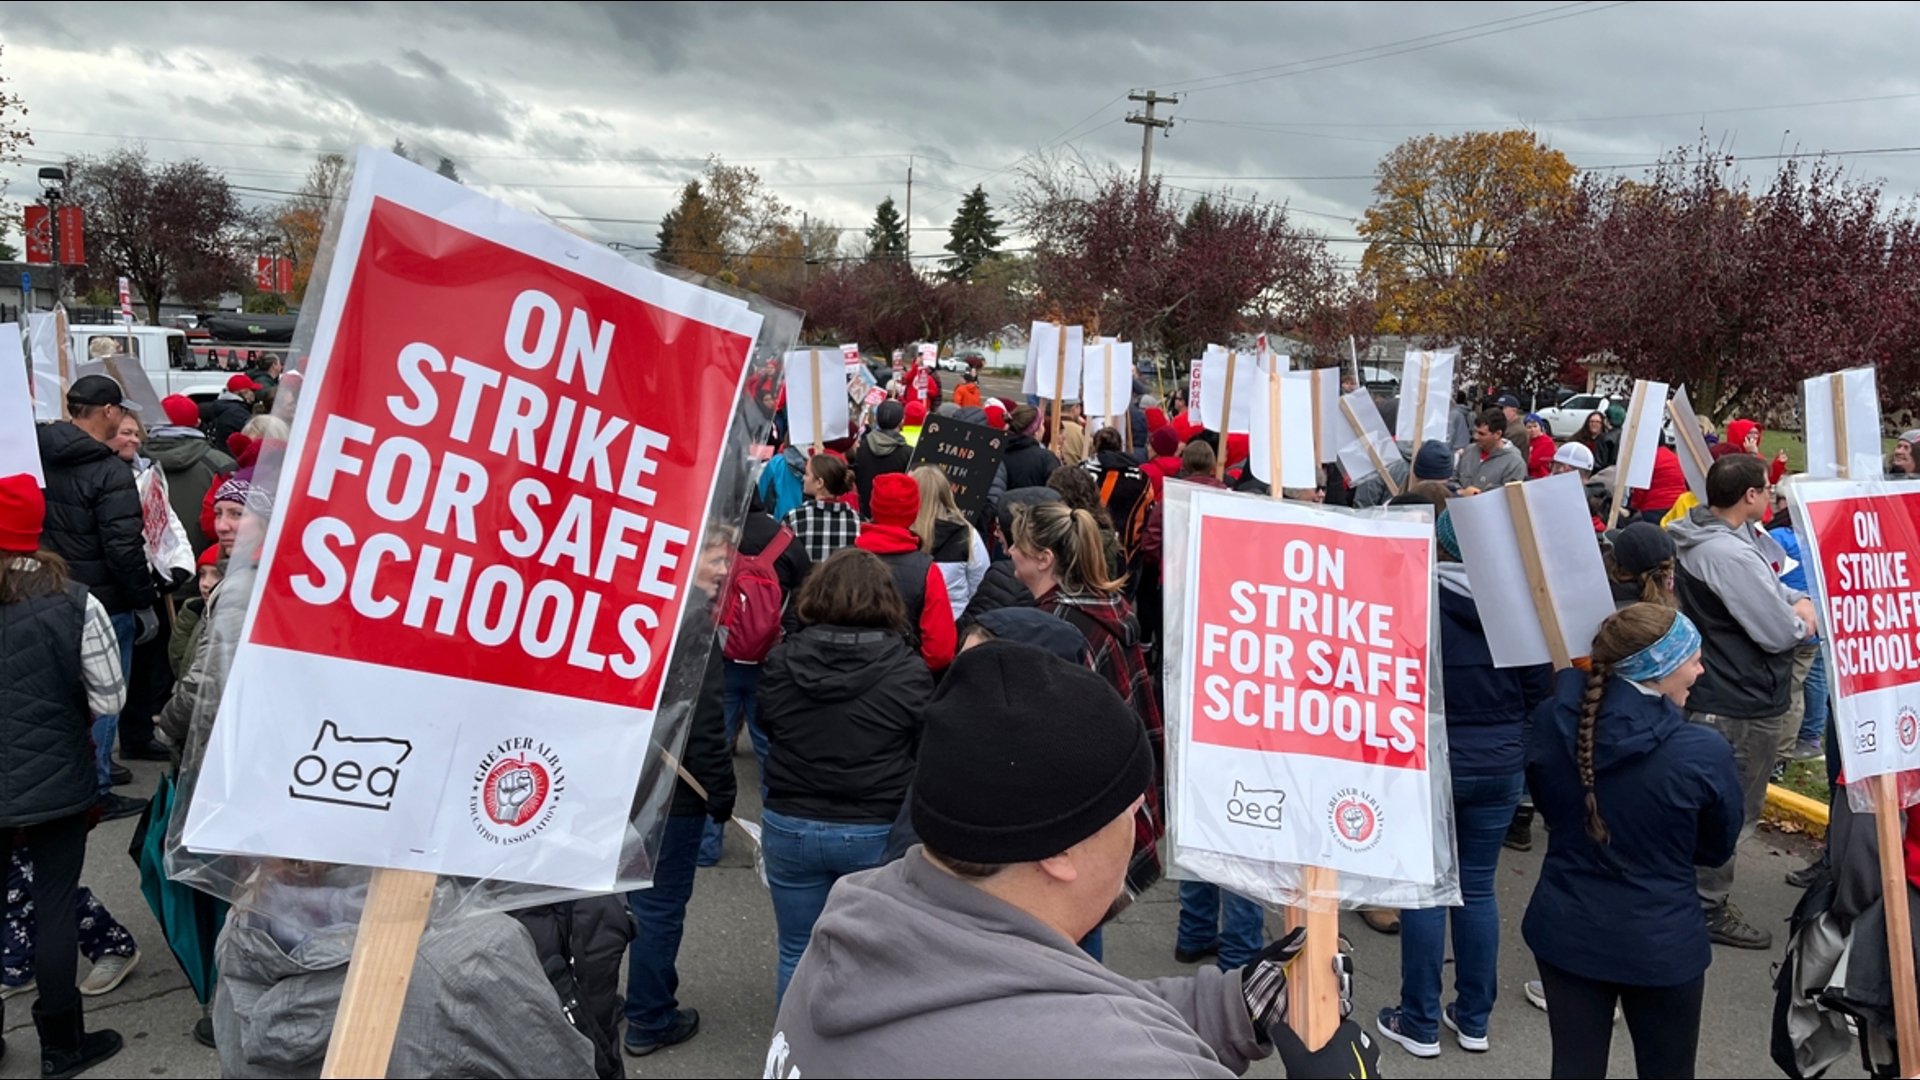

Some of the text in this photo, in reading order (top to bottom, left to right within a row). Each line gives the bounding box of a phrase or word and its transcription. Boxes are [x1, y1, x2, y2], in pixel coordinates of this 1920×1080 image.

[504, 290, 615, 395] ON
[387, 342, 670, 505] STRIKE
[938, 442, 974, 459] STAND
[939, 463, 967, 477] WITH
[307, 414, 488, 543] FOR
[499, 478, 690, 600] SAFE
[1854, 512, 1881, 547] ON
[1283, 540, 1344, 590] ON
[1837, 553, 1909, 590] STRIKE
[290, 516, 658, 679] SCHOOLS
[1229, 581, 1393, 649] STRIKE
[1832, 597, 1870, 633] FOR
[1202, 622, 1421, 703] FOR SAFE
[1203, 674, 1416, 753] SCHOOLS
[293, 754, 400, 797] oea
[475, 737, 566, 794] GREATER ALBANY
[470, 794, 557, 847] EDUCATION ASSOCIATION
[1227, 799, 1282, 823] oea
[1361, 791, 1385, 823] ALBANY
